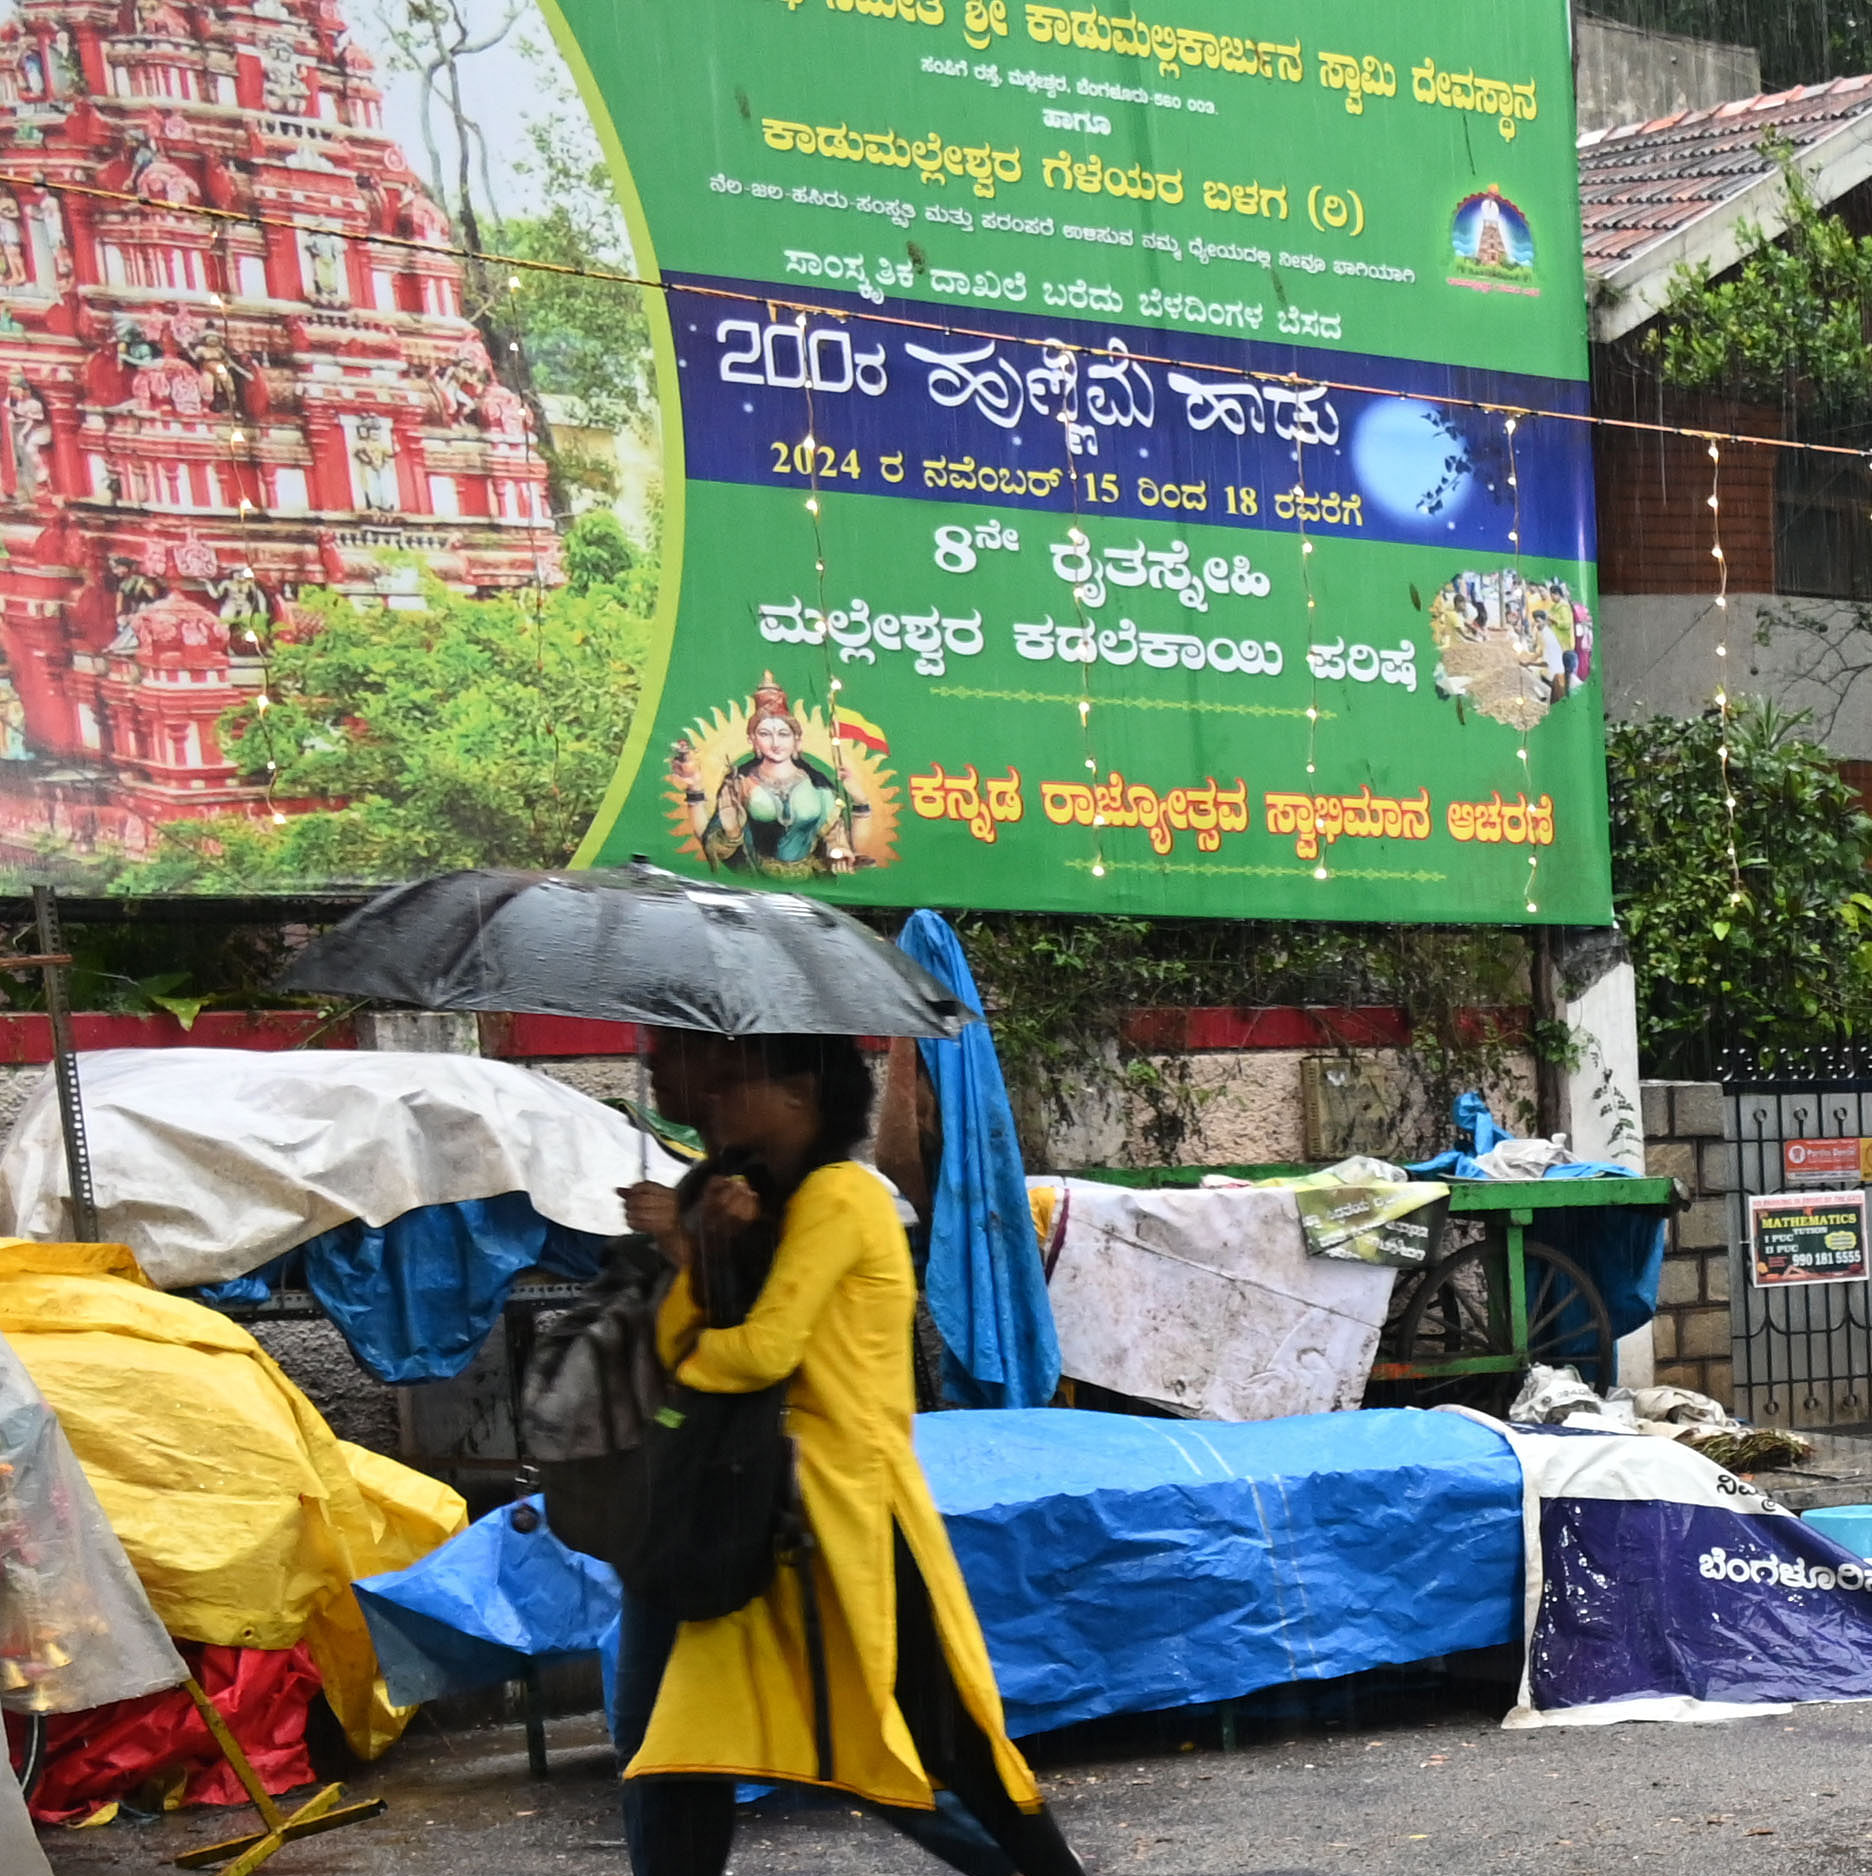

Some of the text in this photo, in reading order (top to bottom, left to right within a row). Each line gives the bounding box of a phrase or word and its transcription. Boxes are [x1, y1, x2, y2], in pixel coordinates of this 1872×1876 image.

[1024, 3, 1304, 83] ಕಾಡುಮಲ್ಲಿಕಾರ್ಜುನ
[1318, 51, 1397, 115] ಸ್ವಾಮಿ
[1411, 56, 1538, 143] ದೇವಸ್ಥಾನ
[1042, 106, 1113, 136] ಹಾಗೂ
[761, 117, 1365, 237] ಕಾಡುಮಲ್ಲೇಶ್ವರ ಗೆಳೆಯರ ಬಳಗ (ರಿ)
[924, 203, 975, 232] ಮತ್ತು
[981, 211, 1054, 237] ಪರಂಪರೆ
[1142, 232, 1183, 261] ನಮ್ಮ
[784, 249, 915, 304] ಸಾಂಸ್ಕೃತಿಕ
[929, 268, 1027, 301] ದಾಖಲೆ
[1042, 279, 1123, 313] ಬರೆದು
[1139, 288, 1263, 329] ಬೆಳದಿಂಗಳ
[716, 319, 888, 396] 200ರ
[1167, 372, 1340, 446] ಹಾಡು
[770, 442, 1363, 526] 2024 ರ ನವೆಂಬರ್ 15 ರಿಂದ 18 ರವರೆಗೆ
[934, 519, 1271, 613] 8ನೇ ರೈತಸ್ನೇಹಿ
[759, 595, 1416, 692] ಮಲ್ಲೇಶ್ವರ ಕಡಲೆಕಾಯಿ ಪರಿಷೆ
[909, 761, 1554, 860] ಕನ್ನಡ ರಾಜ್ಯೋತ್ಸವ ಸ್ವಾಭಿಮಾನ ಆಚರಣೆ
[1762, 1213, 1857, 1229] MATHEMATICS
[1772, 1234, 1794, 1243] PUC
[1777, 1244, 1799, 1253] PUC
[1792, 1254, 1813, 1266] 990
[1815, 1252, 1833, 1265] 181
[1835, 1250, 1861, 1263] 5555
